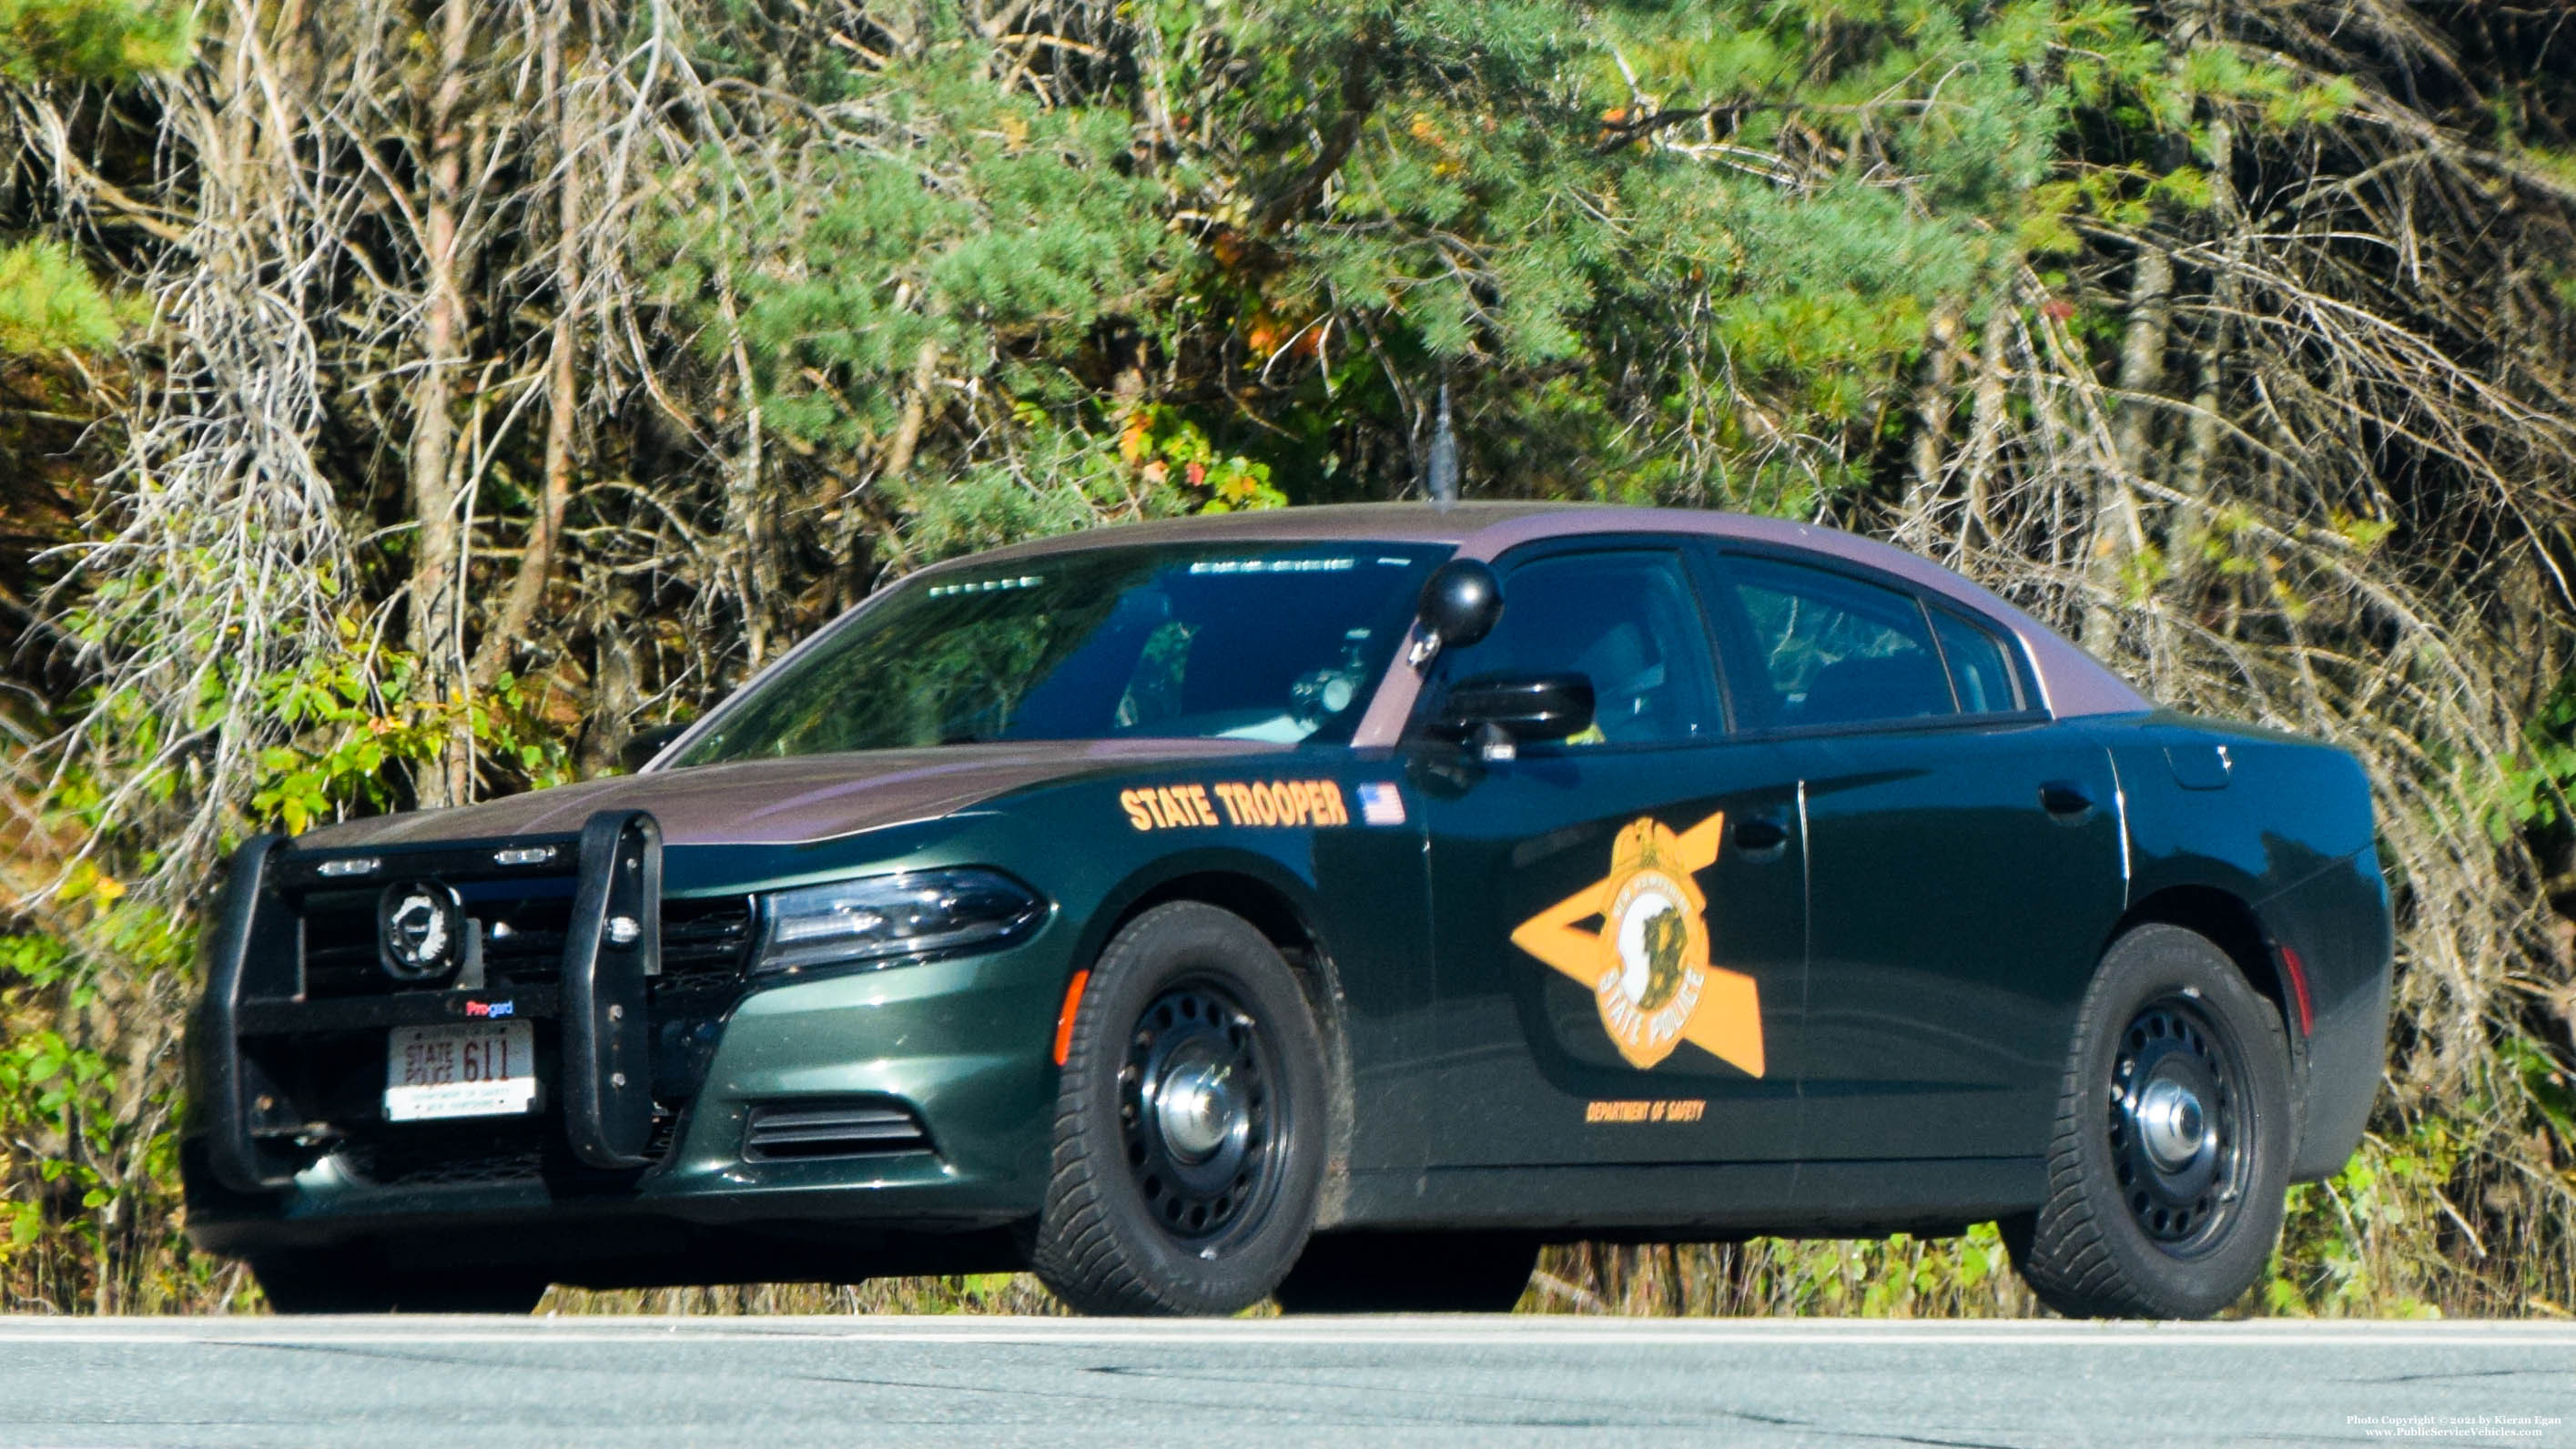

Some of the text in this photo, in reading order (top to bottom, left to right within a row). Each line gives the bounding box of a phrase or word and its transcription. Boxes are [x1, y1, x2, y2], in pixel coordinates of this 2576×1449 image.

[1121, 780, 1349, 832] STATE TROOPER
[1598, 966, 1706, 1049] STATE POLICE
[405, 1039, 511, 1083] STATE 611
[1587, 1099, 1707, 1122] DEPARTMENT OF SAFETY
